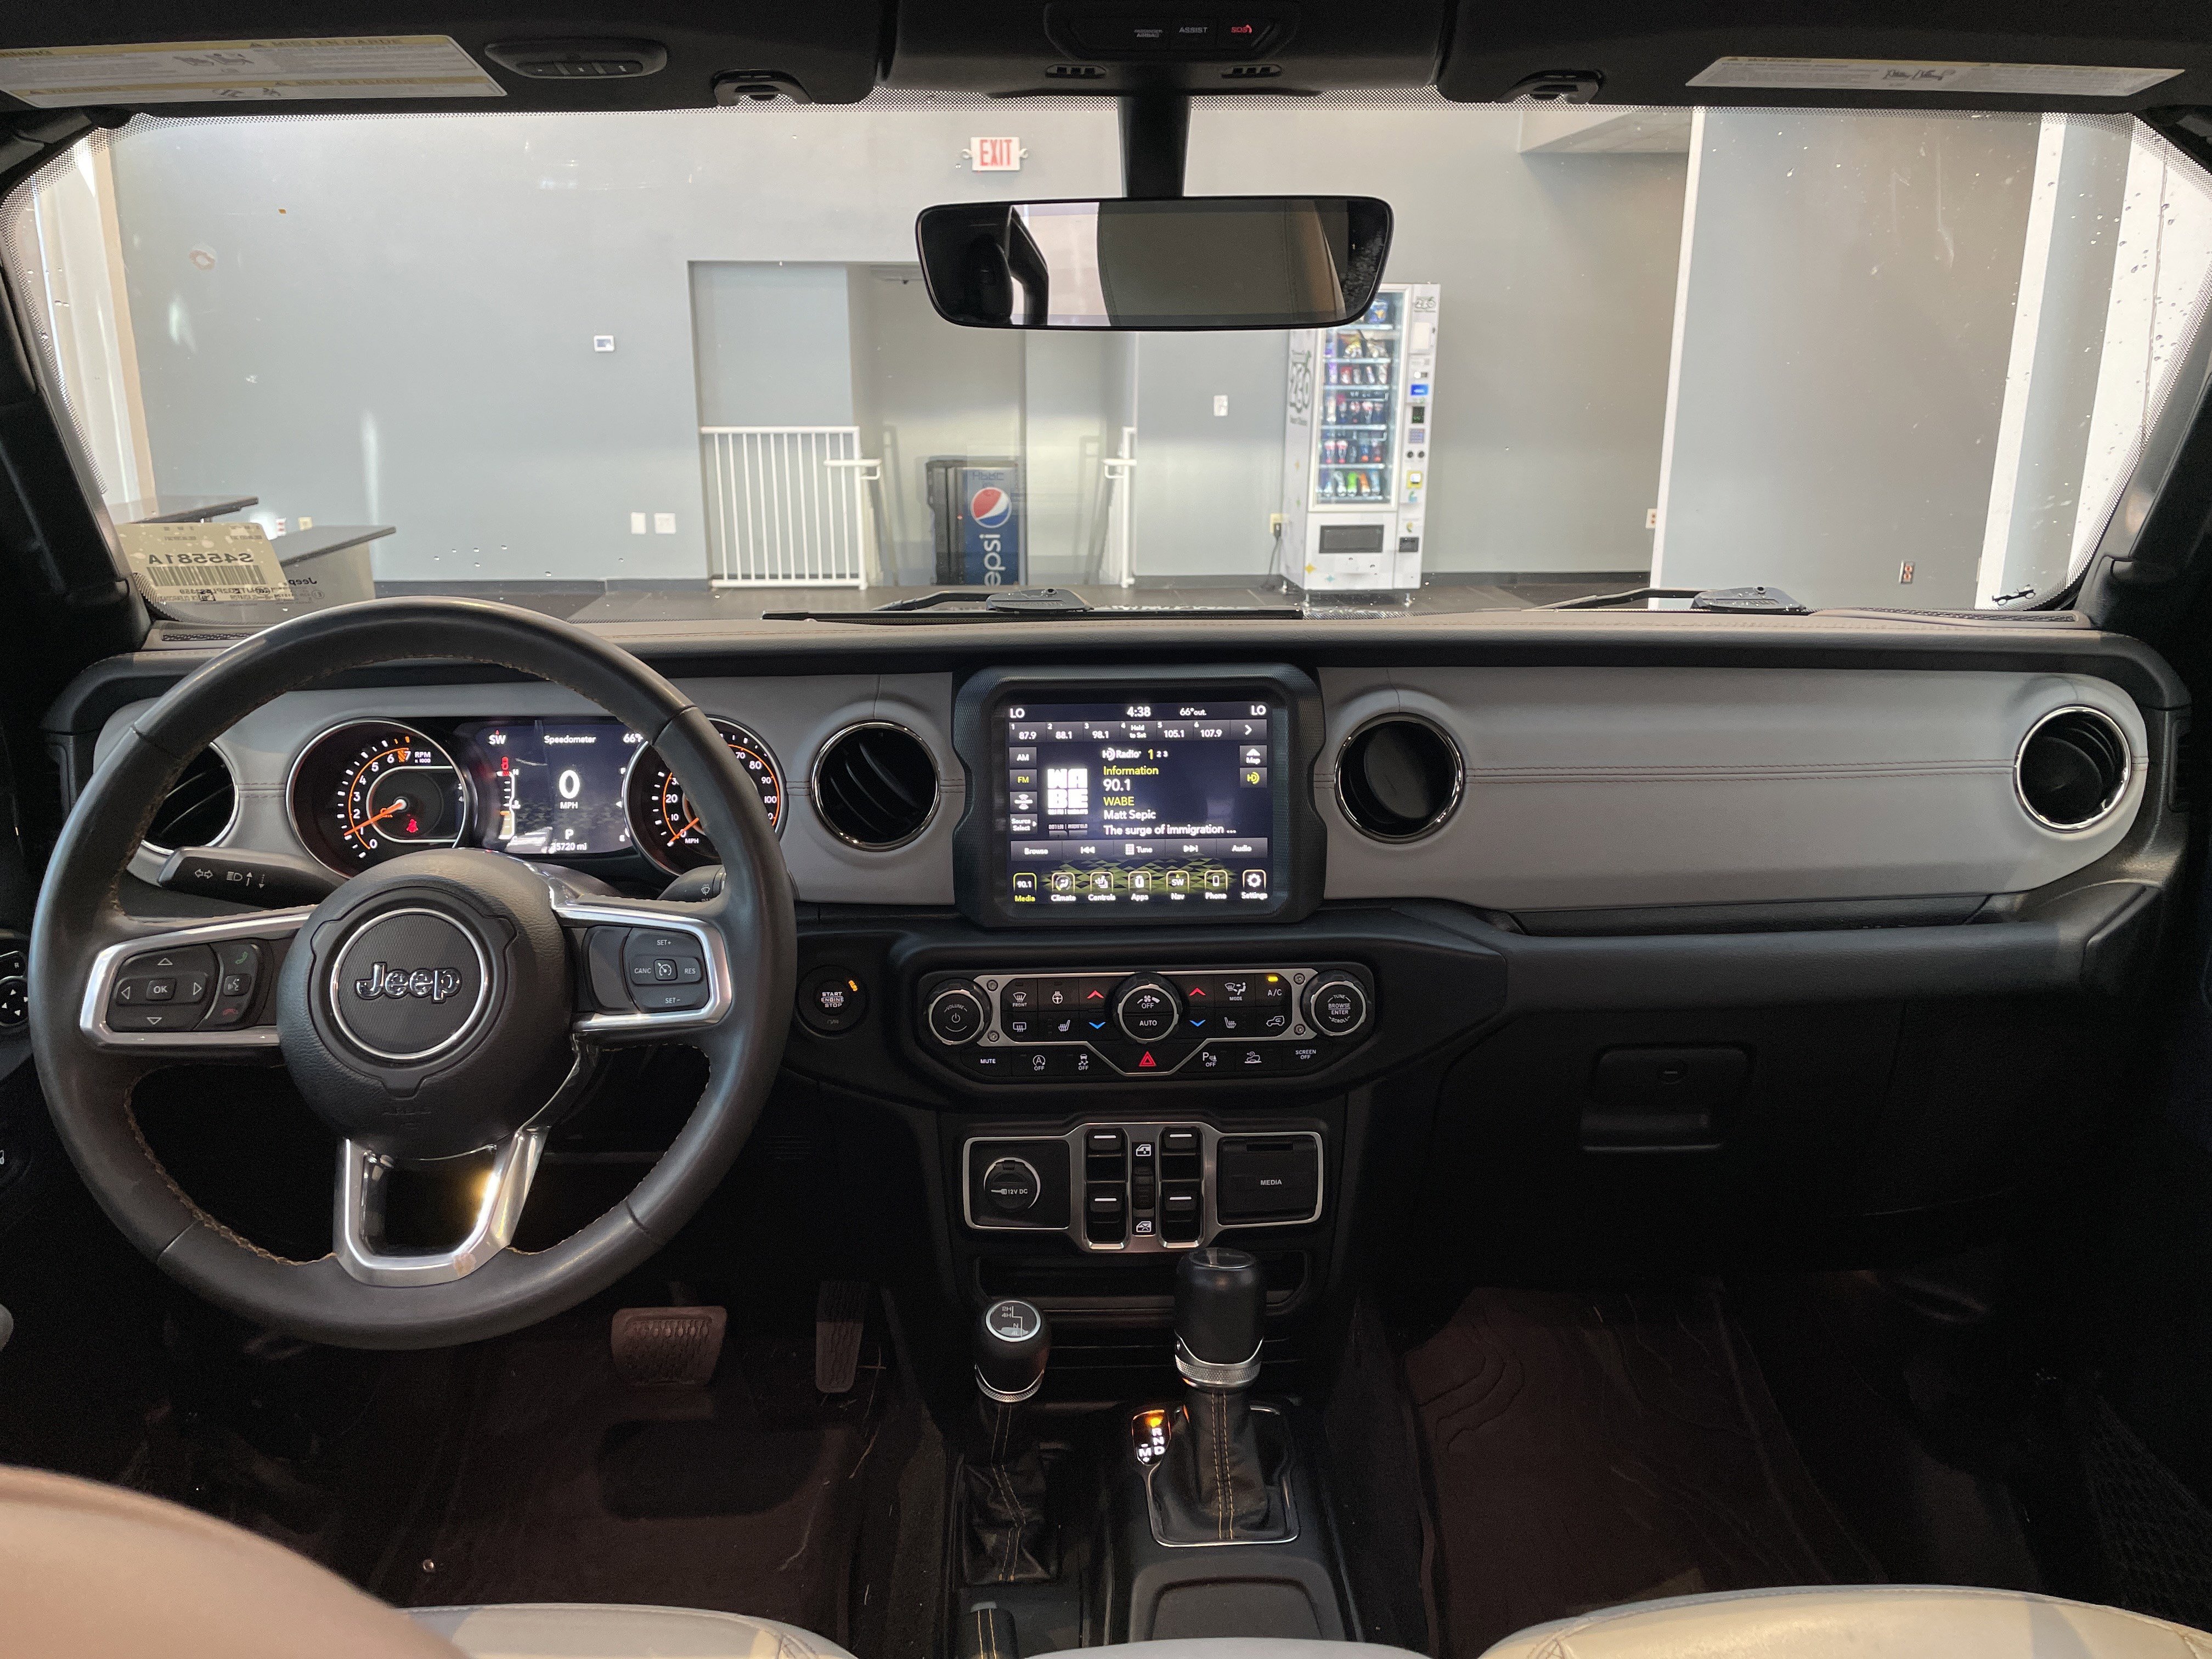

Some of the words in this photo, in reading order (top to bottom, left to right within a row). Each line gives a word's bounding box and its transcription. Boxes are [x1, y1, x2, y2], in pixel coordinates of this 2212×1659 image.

[980, 139, 1012, 166] EXIT
[1009, 708, 1025, 719] LO
[1127, 706, 1152, 717] 4:38
[1251, 704, 1267, 715] LO
[1018, 731, 1037, 740] 87.9
[1055, 731, 1073, 740] 88.1
[1092, 731, 1109, 739] 98.1
[1164, 730, 1185, 738] 105.1
[1200, 729, 1222, 738] 107.9
[489, 735, 506, 745] SW
[544, 735, 596, 745] Speedometer
[386, 753, 395, 764] 6
[404, 751, 411, 761] 7
[1147, 749, 1153, 760] 1
[749, 760, 762, 770] 80
[1245, 757, 1261, 765] Map
[371, 761, 379, 772] 5
[1103, 765, 1159, 775] Information
[359, 775, 367, 786] 4
[558, 769, 580, 799] 0
[1103, 778, 1131, 792] 90.1
[353, 791, 361, 802] 3
[665, 794, 678, 804] 20
[764, 795, 777, 804] 100
[1103, 796, 1135, 806] WABE
[560, 801, 578, 809] MPH
[352, 808, 360, 819] 2
[1103, 810, 1127, 820] Matt
[1128, 809, 1156, 821] Sepic
[565, 829, 574, 840] P
[1103, 824, 1124, 835] The
[1125, 826, 1152, 837] surge
[1154, 824, 1165, 835] of
[1166, 823, 1224, 837] immigration
[369, 838, 378, 849] 0
[577, 842, 587, 850] mi
[1024, 847, 1049, 855] Browse
[1051, 894, 1077, 902] Climate
[1241, 891, 1268, 900] Settings
[355, 961, 462, 1003] Jeep
[154, 985, 168, 994] OK
[1202, 1052, 1209, 1061] P
[1152, 1427, 1163, 1436] R
[1153, 1436, 1164, 1446] N
[1138, 1447, 1152, 1457] M
[1154, 1446, 1165, 1455] D
